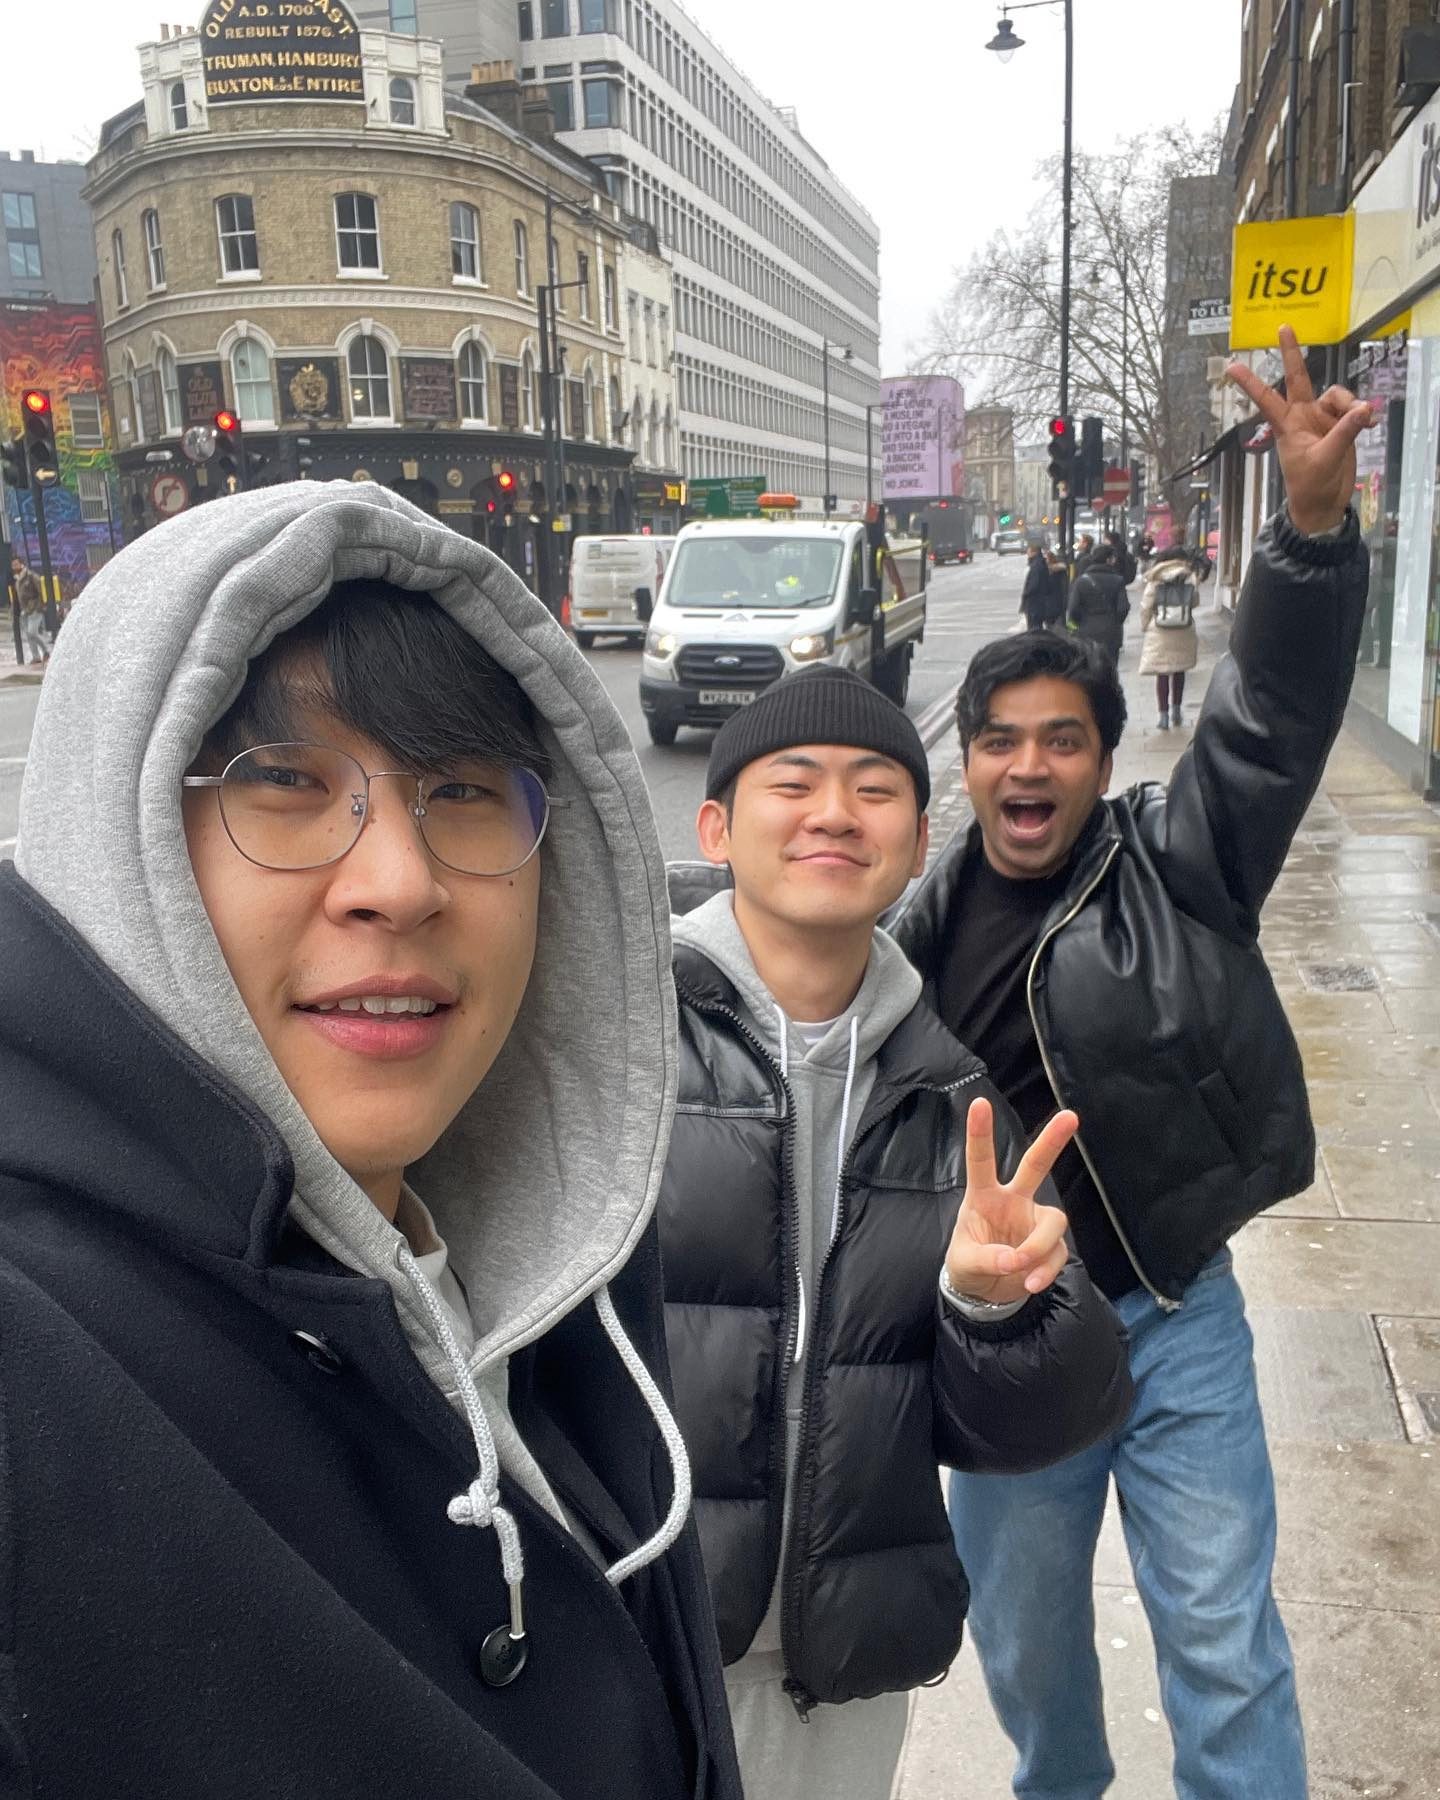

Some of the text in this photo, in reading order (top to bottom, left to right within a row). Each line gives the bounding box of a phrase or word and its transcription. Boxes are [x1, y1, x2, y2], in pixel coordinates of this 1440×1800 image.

[206, 0, 235, 38] OLD
[225, 25, 290, 40] REBUILT
[277, 52, 360, 68] HANBURY
[207, 76, 274, 97] BUXTON
[293, 74, 363, 93] ENTIRE
[1248, 260, 1328, 300] itsu
[1191, 307, 1208, 319] TO
